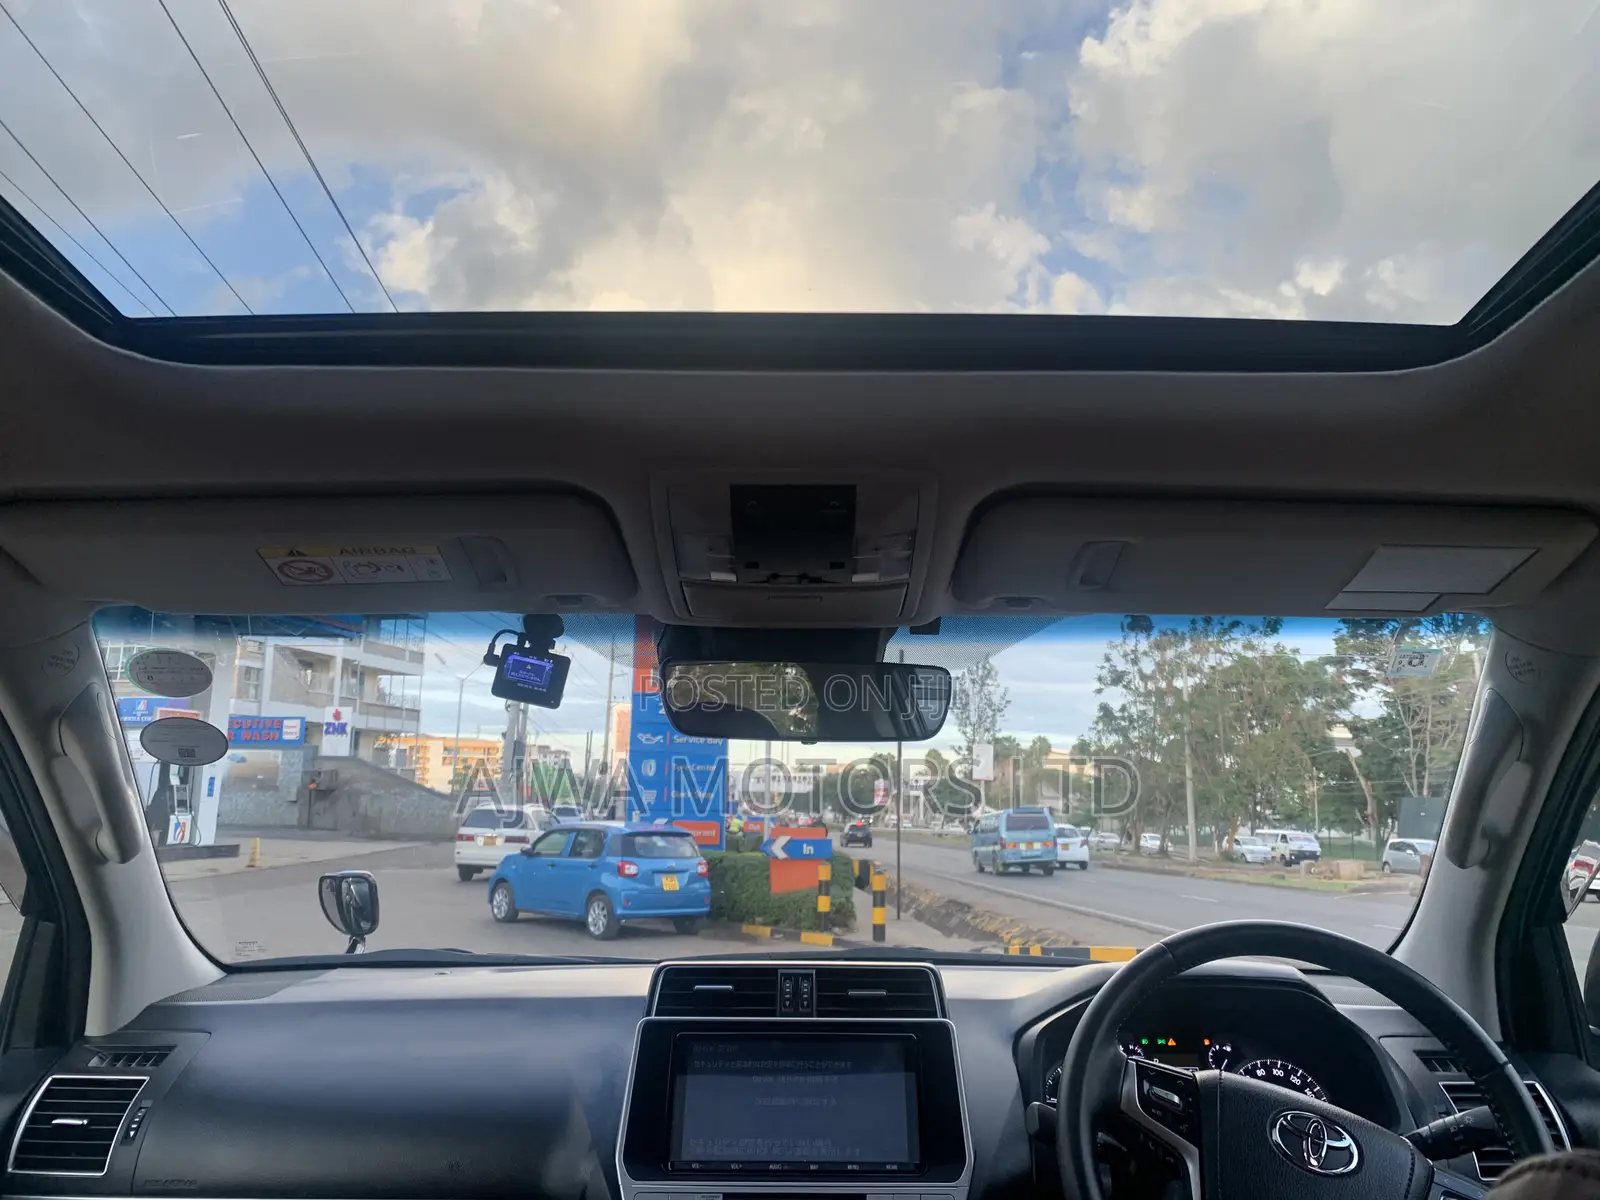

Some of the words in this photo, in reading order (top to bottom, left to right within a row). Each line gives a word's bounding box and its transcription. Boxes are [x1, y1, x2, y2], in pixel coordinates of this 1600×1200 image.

[242, 731, 279, 741] WASH
[803, 843, 814, 855] In
[1256, 1068, 1266, 1077] 80
[1272, 1068, 1284, 1077] 100
[1290, 1075, 1302, 1086] 120
